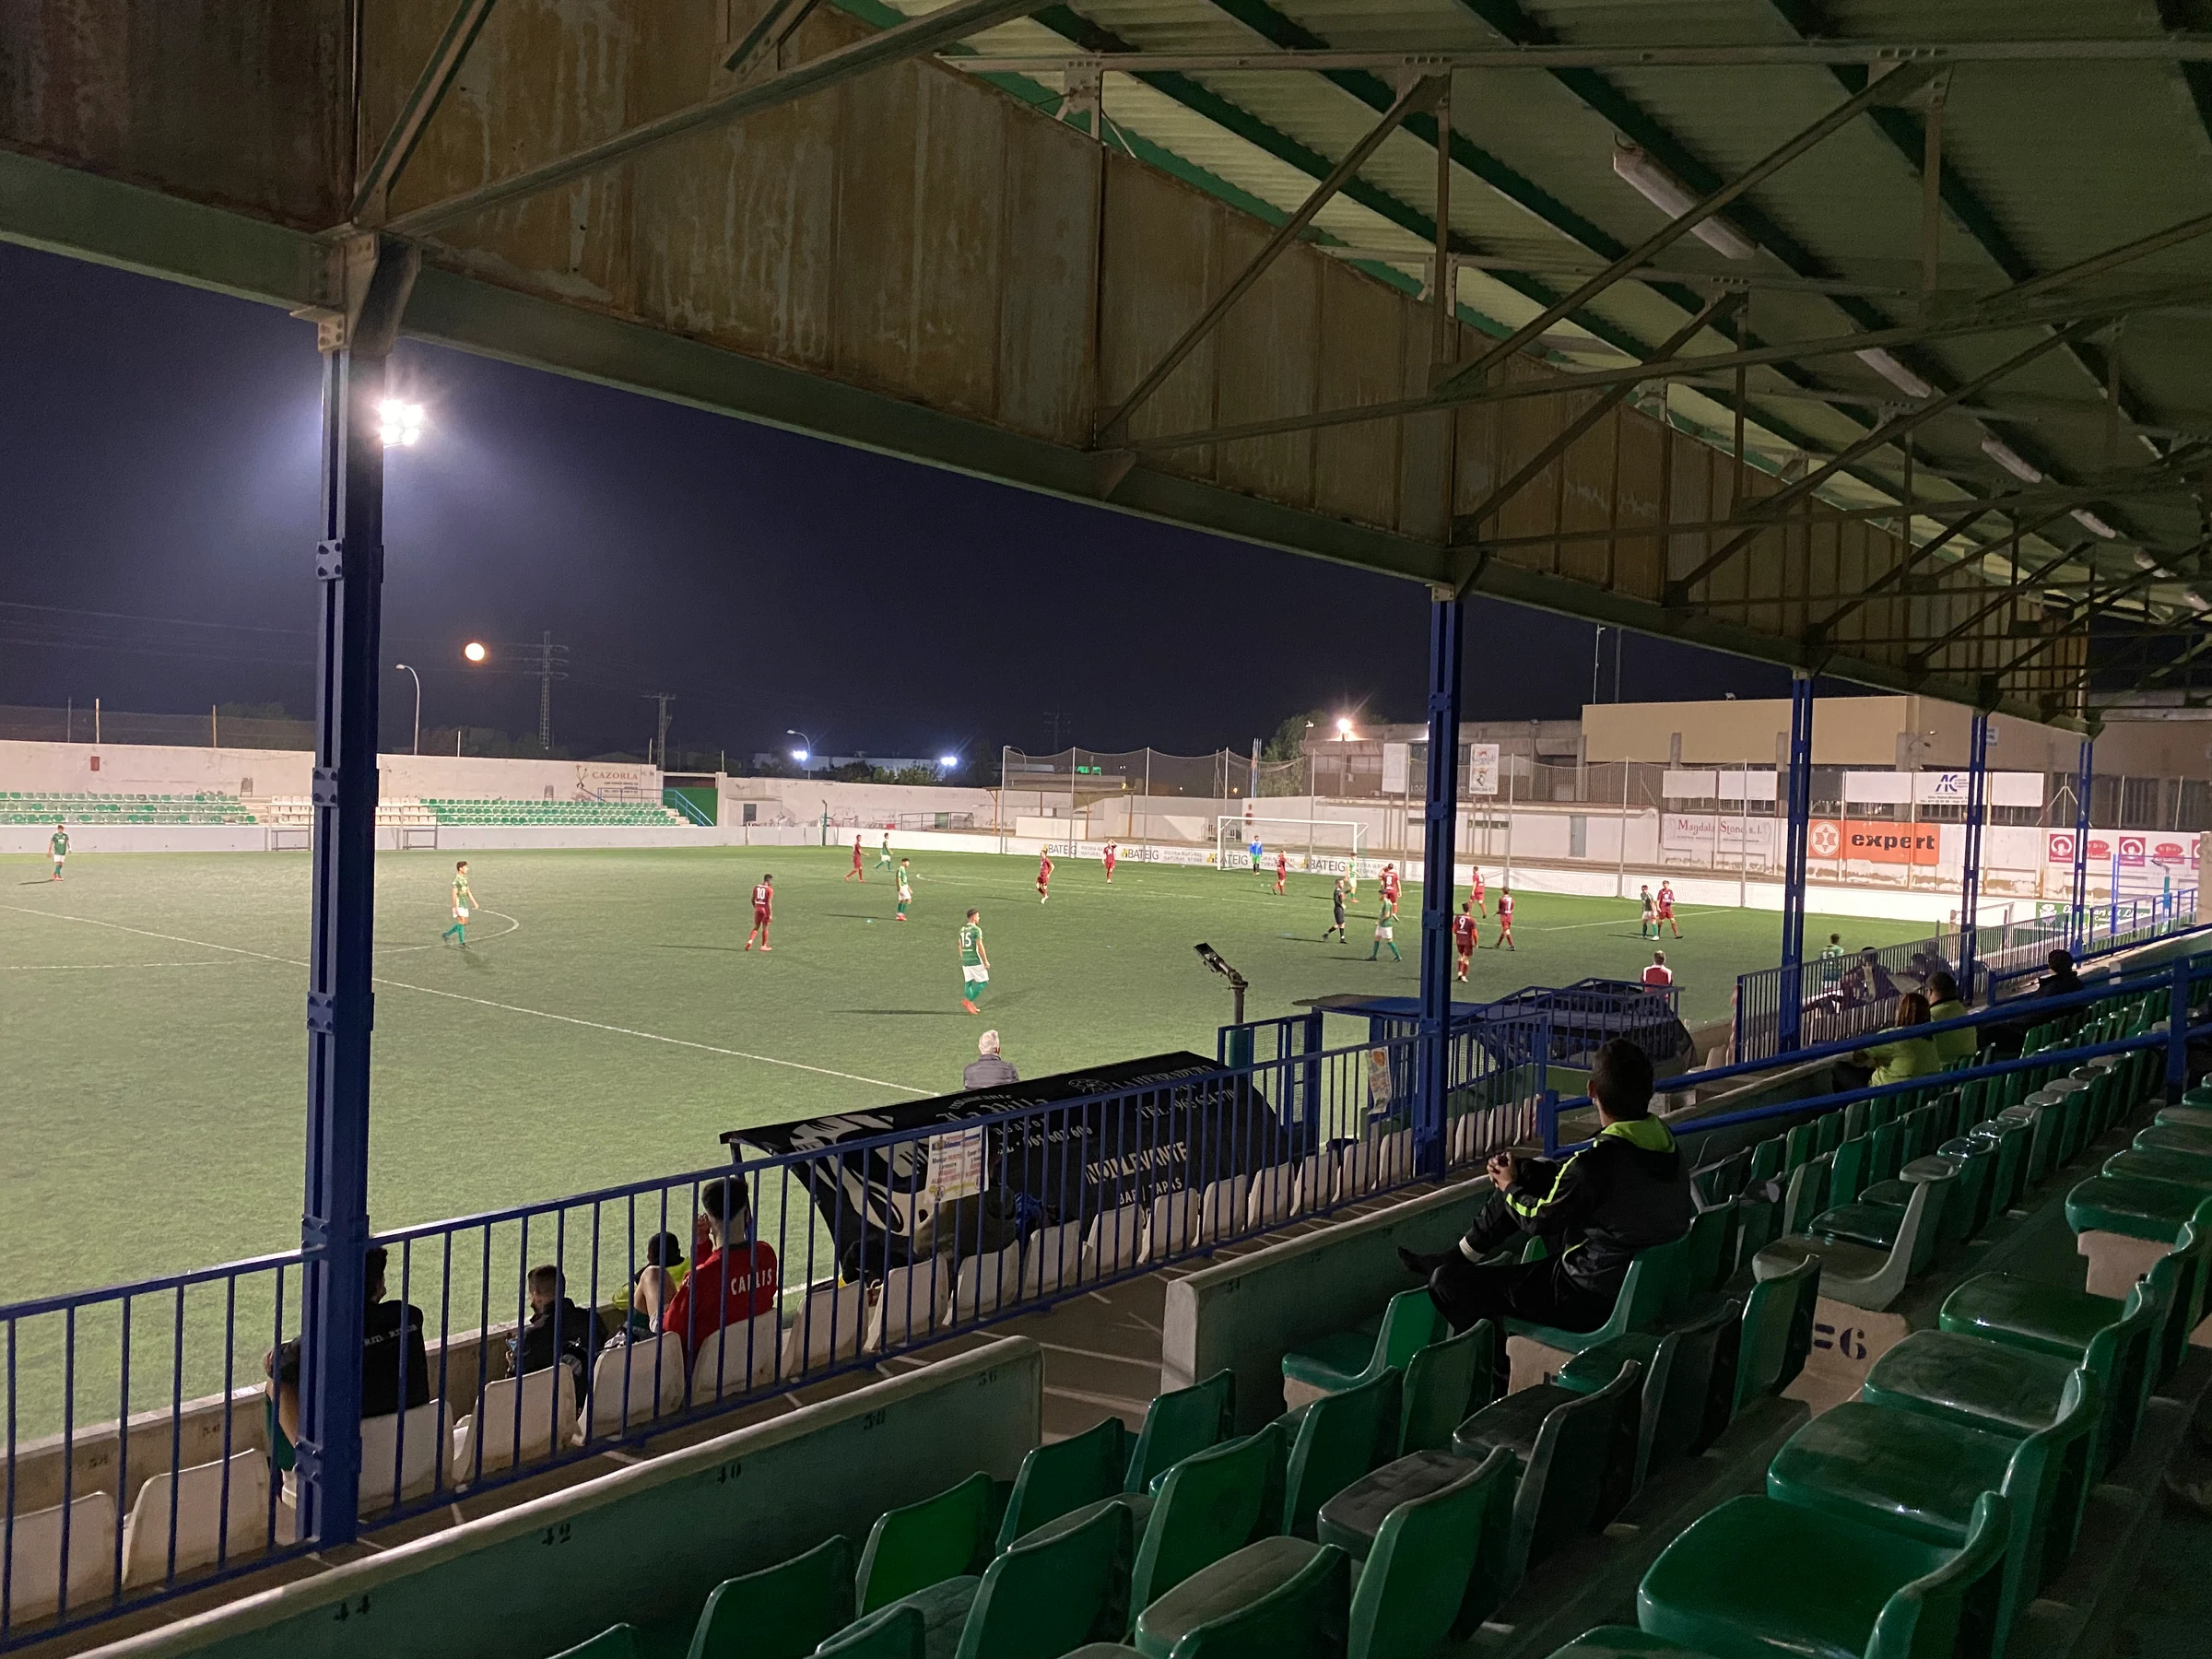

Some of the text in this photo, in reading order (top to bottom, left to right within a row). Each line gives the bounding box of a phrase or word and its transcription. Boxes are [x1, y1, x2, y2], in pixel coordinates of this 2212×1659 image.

[592, 771, 638, 780] CAZORLA
[1852, 833, 1935, 850] expert
[1048, 844, 1077, 854] BATEG
[1128, 848, 1159, 860] BATEIG
[1311, 858, 1346, 872] BATEIG
[1386, 876, 1393, 886] 8
[756, 887, 765, 900] 10
[1459, 917, 1466, 929] 9
[959, 931, 971, 947] 15
[1148, 1177, 1182, 1195] APS
